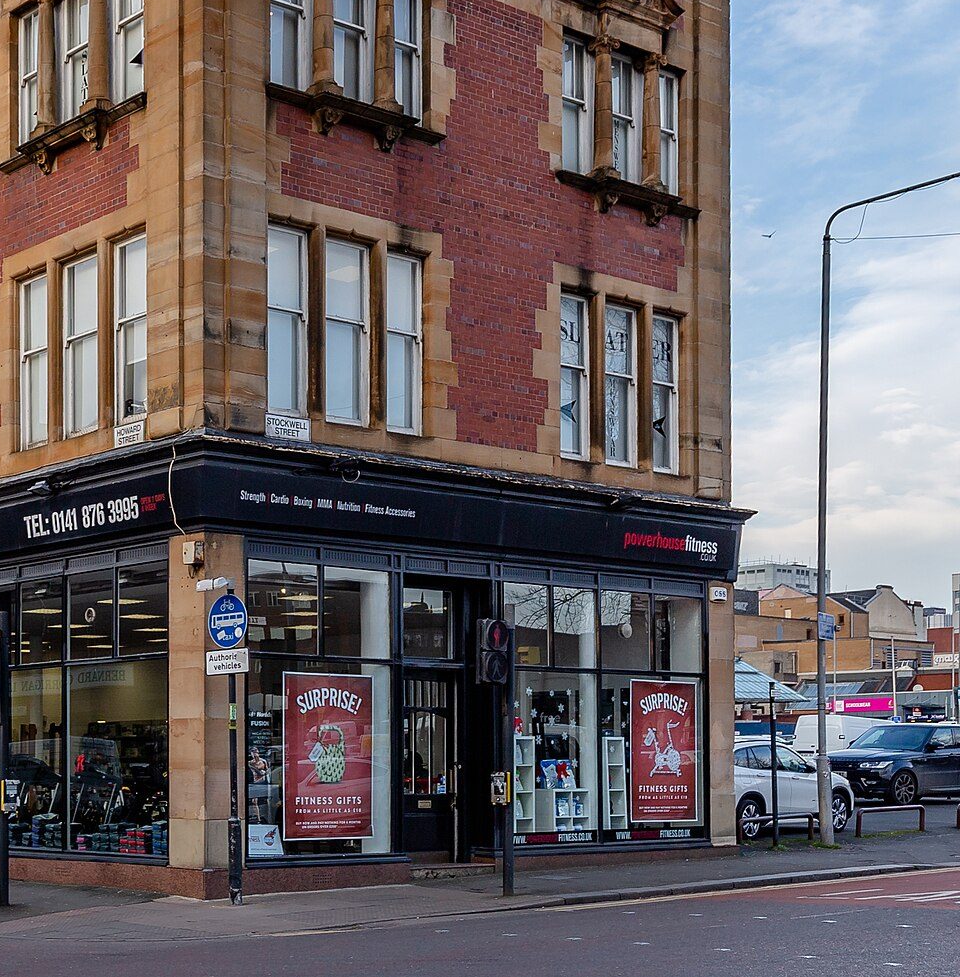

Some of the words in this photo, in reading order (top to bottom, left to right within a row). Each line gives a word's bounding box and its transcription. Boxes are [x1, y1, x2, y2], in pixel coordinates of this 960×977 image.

[267, 417, 307, 430] STOCKWELL
[117, 424, 141, 437] HOWARD
[275, 427, 300, 437] STREET
[118, 433, 140, 445] STREET
[240, 490, 266, 504] Strength
[270, 493, 289, 505] Cardio
[294, 496, 313, 509] Boxing
[317, 498, 333, 509] MMA
[337, 500, 360, 512] Nutrition
[365, 503, 384, 515] Fitness
[385, 507, 416, 518] Accessories
[24, 514, 50, 538] TEL:
[52, 508, 78, 533] 0141
[82, 502, 105, 528] 876
[107, 495, 139, 524] 3995
[624, 532, 718, 555] powerhousefitness
[214, 662, 242, 671] vehicles
[296, 687, 362, 715] SURPRISE!
[640, 692, 688, 716] SURPRISE!
[639, 785, 668, 793] FITNESS
[669, 785, 688, 793] GIFTS
[296, 797, 333, 805] FITNESS
[336, 796, 362, 805] GIFTS
